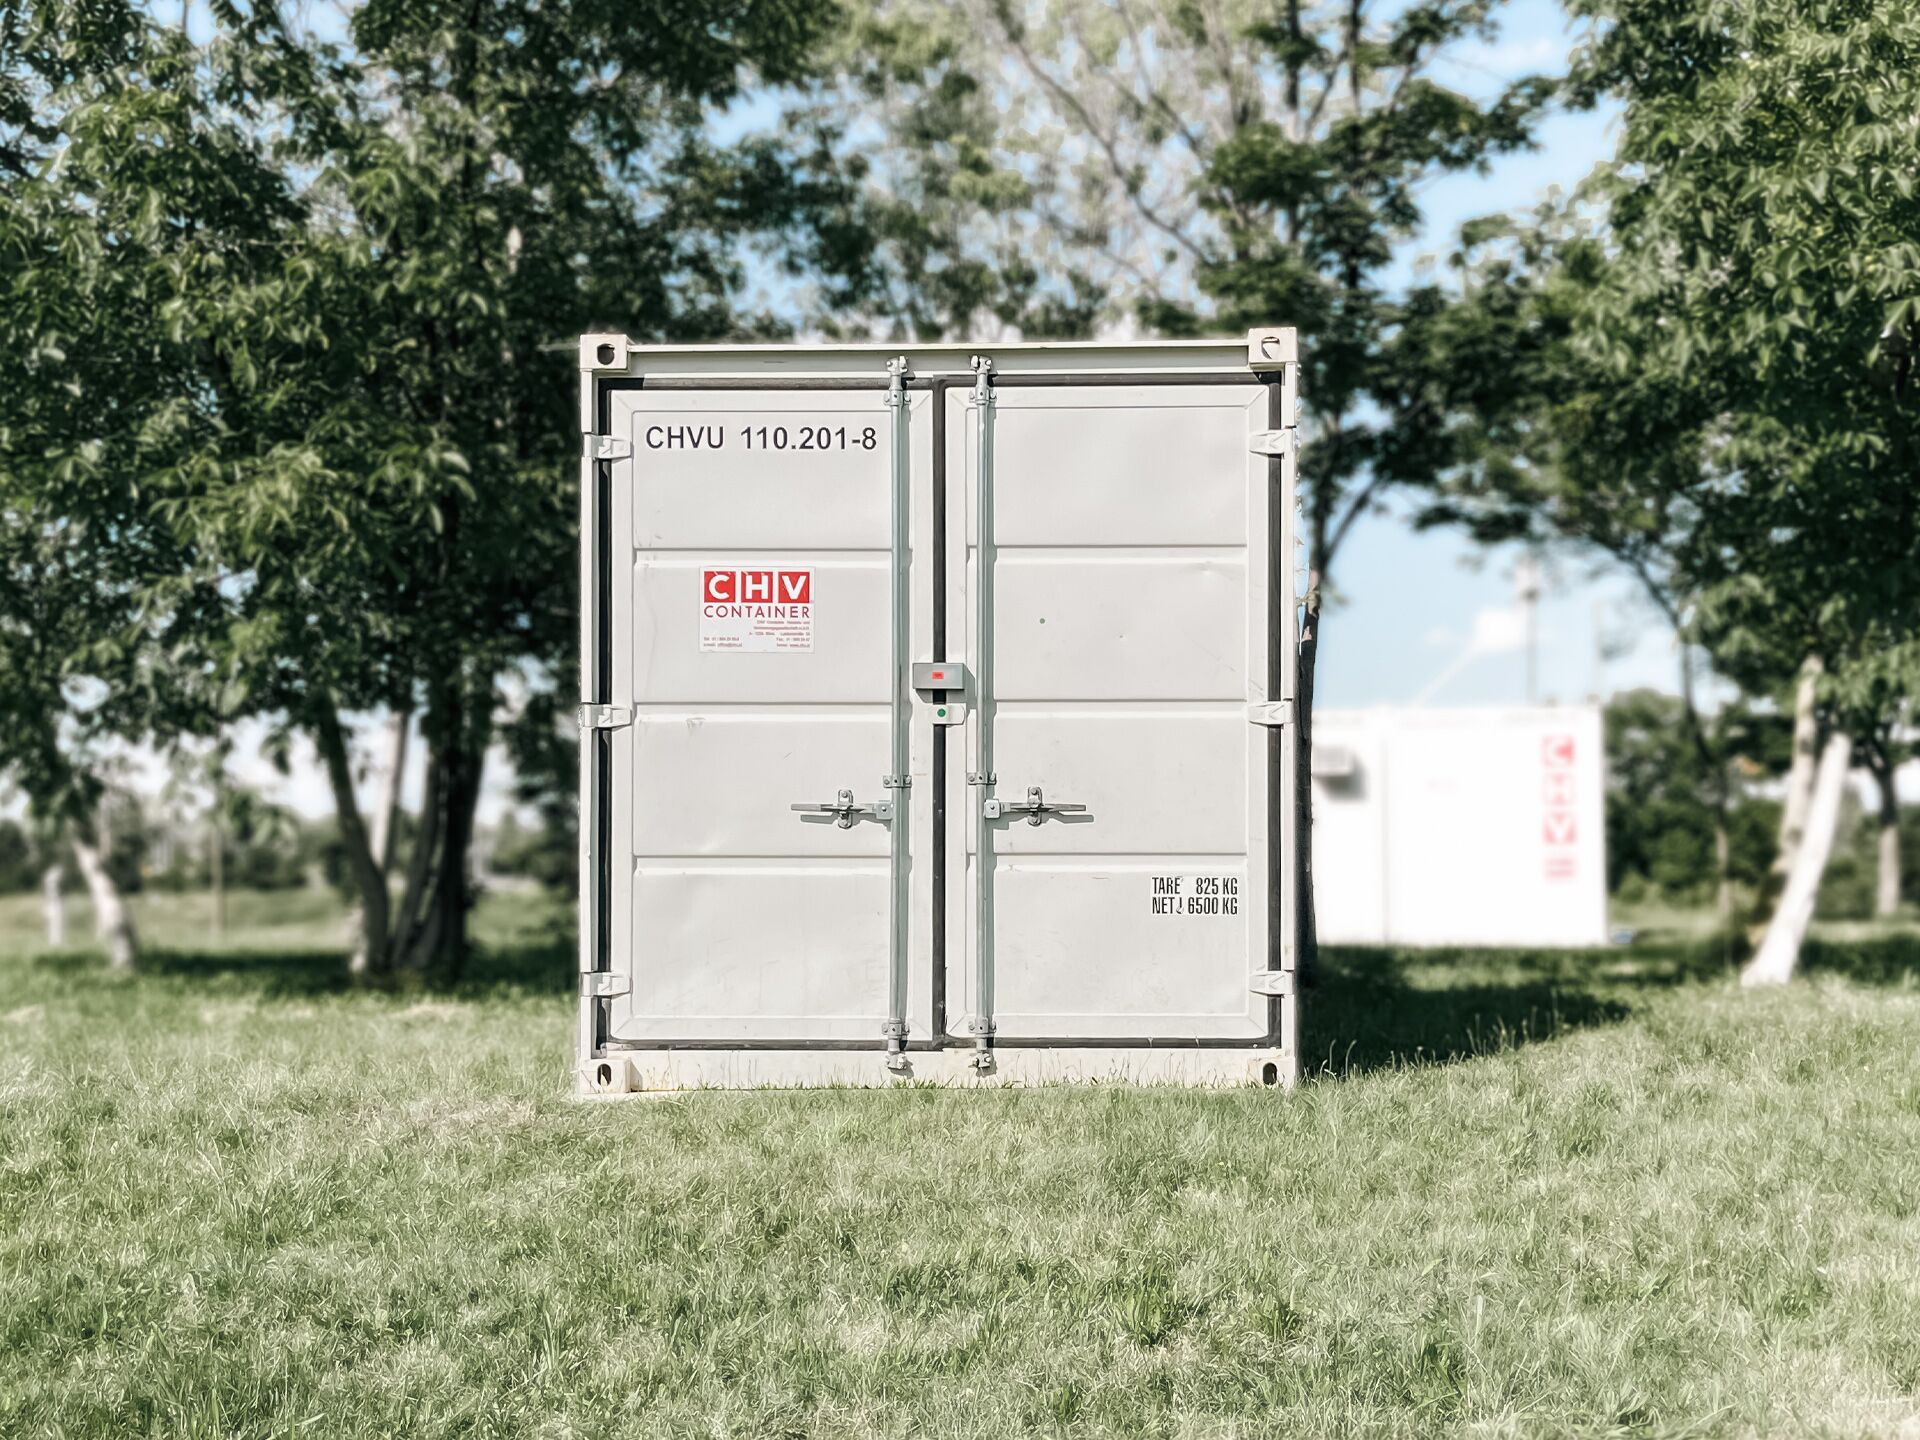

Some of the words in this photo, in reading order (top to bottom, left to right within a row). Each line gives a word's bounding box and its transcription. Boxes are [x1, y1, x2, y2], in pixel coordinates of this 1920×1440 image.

[645, 426, 724, 449] CHVU
[740, 426, 877, 450] 110.201-8
[708, 573, 808, 601] CHV
[703, 605, 810, 619] CONTAINER
[1152, 877, 1180, 894] TARE
[1196, 876, 1219, 895] 825
[1222, 876, 1238, 895] KG
[1187, 896, 1219, 915] 6500
[1222, 896, 1238, 915] KG
